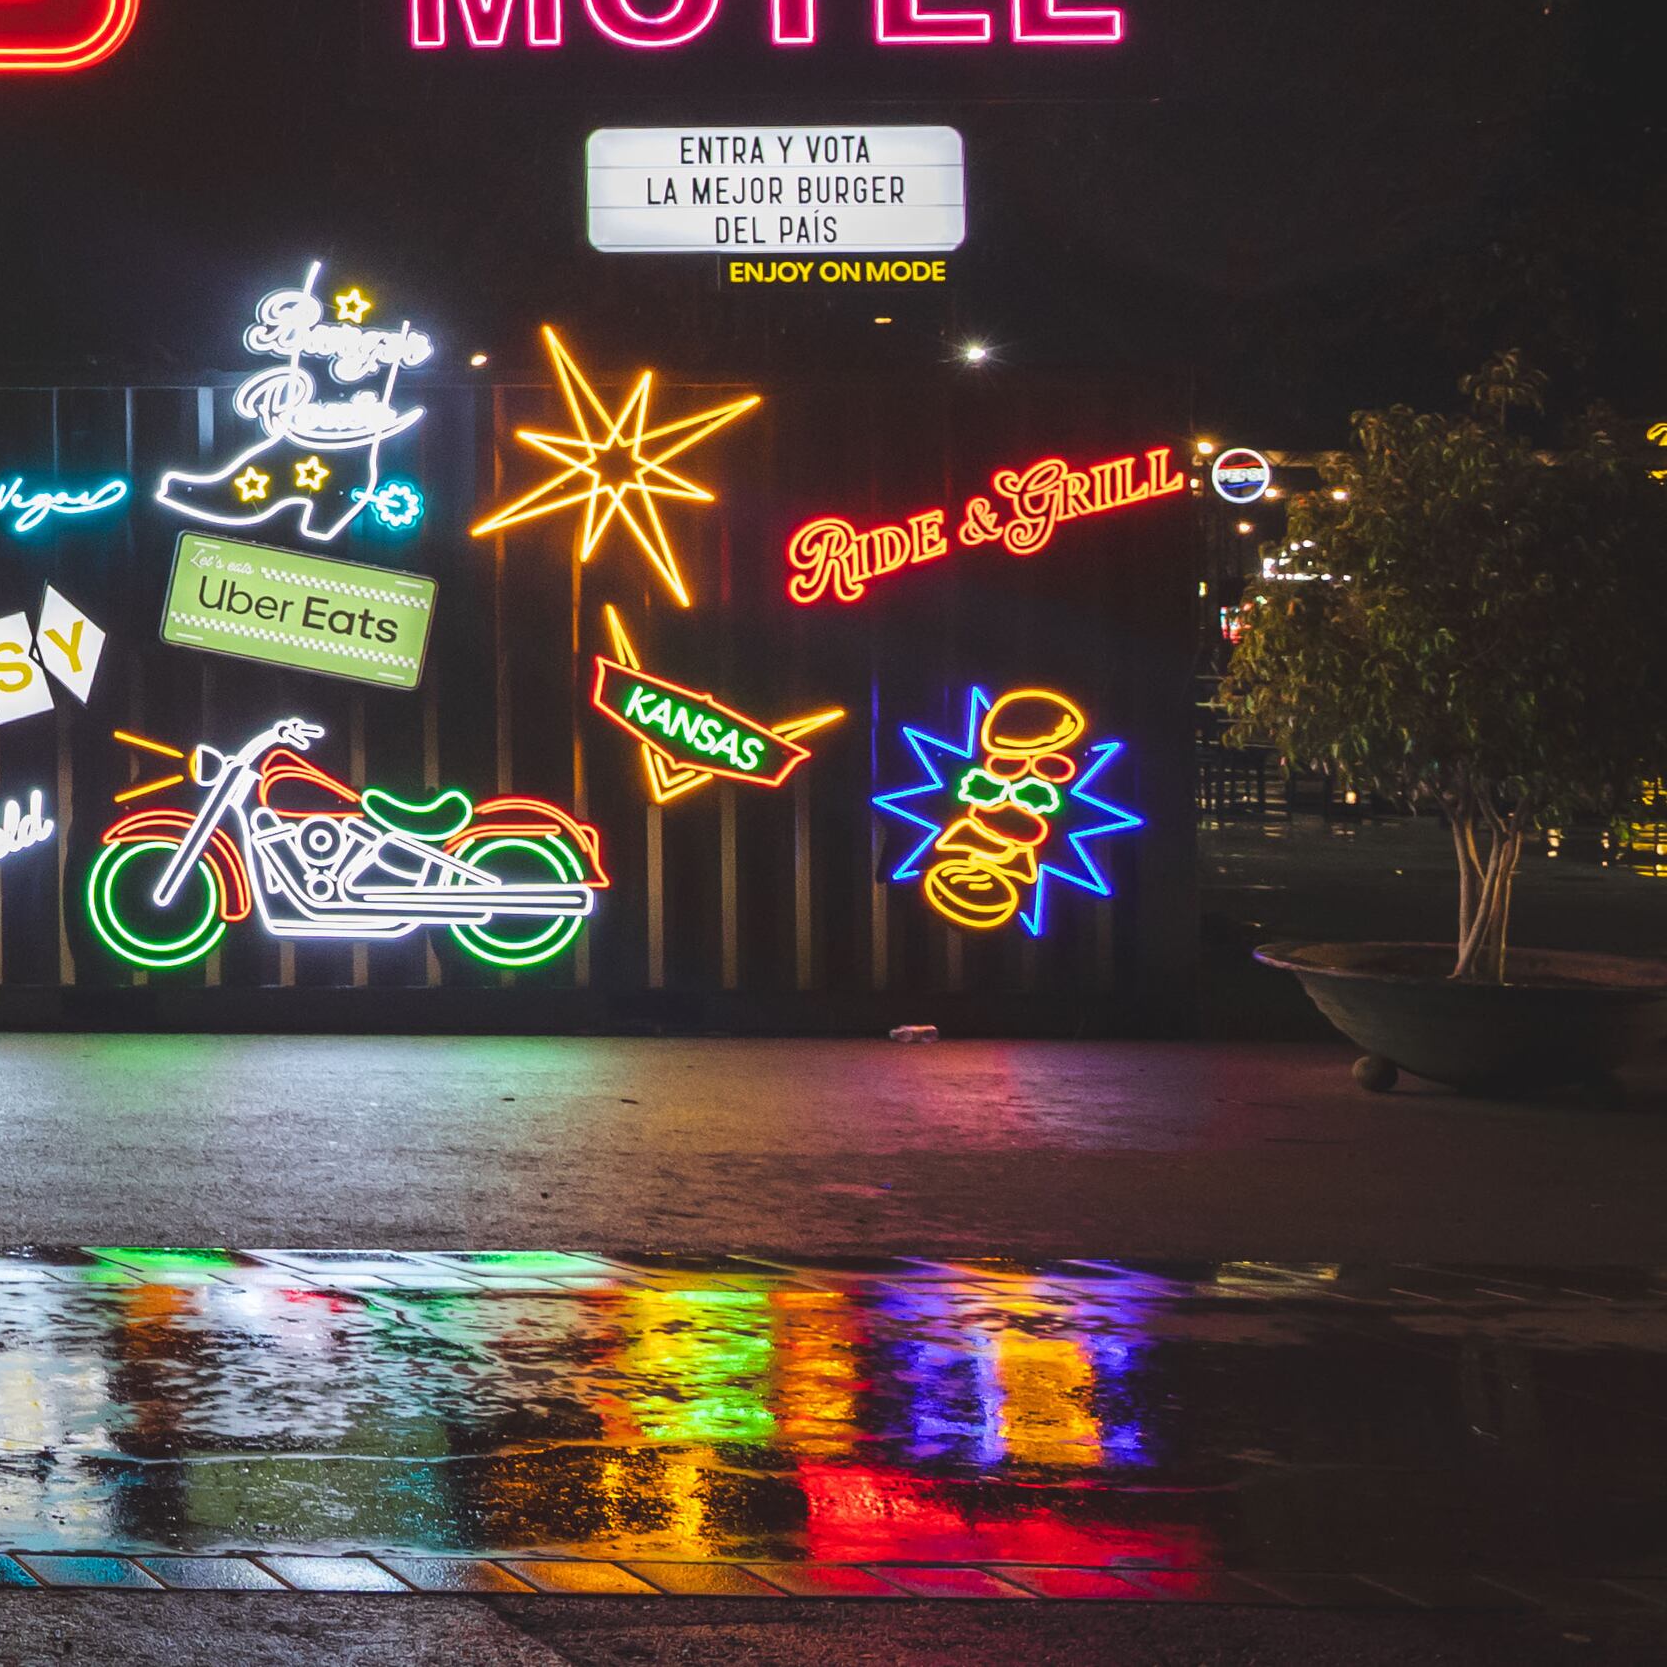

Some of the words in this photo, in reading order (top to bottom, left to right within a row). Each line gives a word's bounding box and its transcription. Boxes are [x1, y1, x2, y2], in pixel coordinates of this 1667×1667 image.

[680, 136, 765, 165] ENTRA
[777, 135, 794, 165] Y
[806, 135, 871, 164] VOTA
[646, 177, 678, 206] LA
[692, 176, 784, 205] MEJOR
[798, 175, 906, 204] BURGER
[715, 216, 766, 244] DEL
[780, 209, 839, 244] PAÍS
[729, 261, 816, 284] ENJOY
[819, 261, 862, 284] ON
[866, 260, 947, 283] MODE
[787, 509, 948, 606] RIDE
[959, 495, 1003, 547] &
[996, 447, 1184, 556] GRILL
[189, 548, 224, 570] Let's
[198, 575, 294, 623] Uber
[301, 595, 399, 644] Eats
[625, 684, 766, 773] KANSAS
